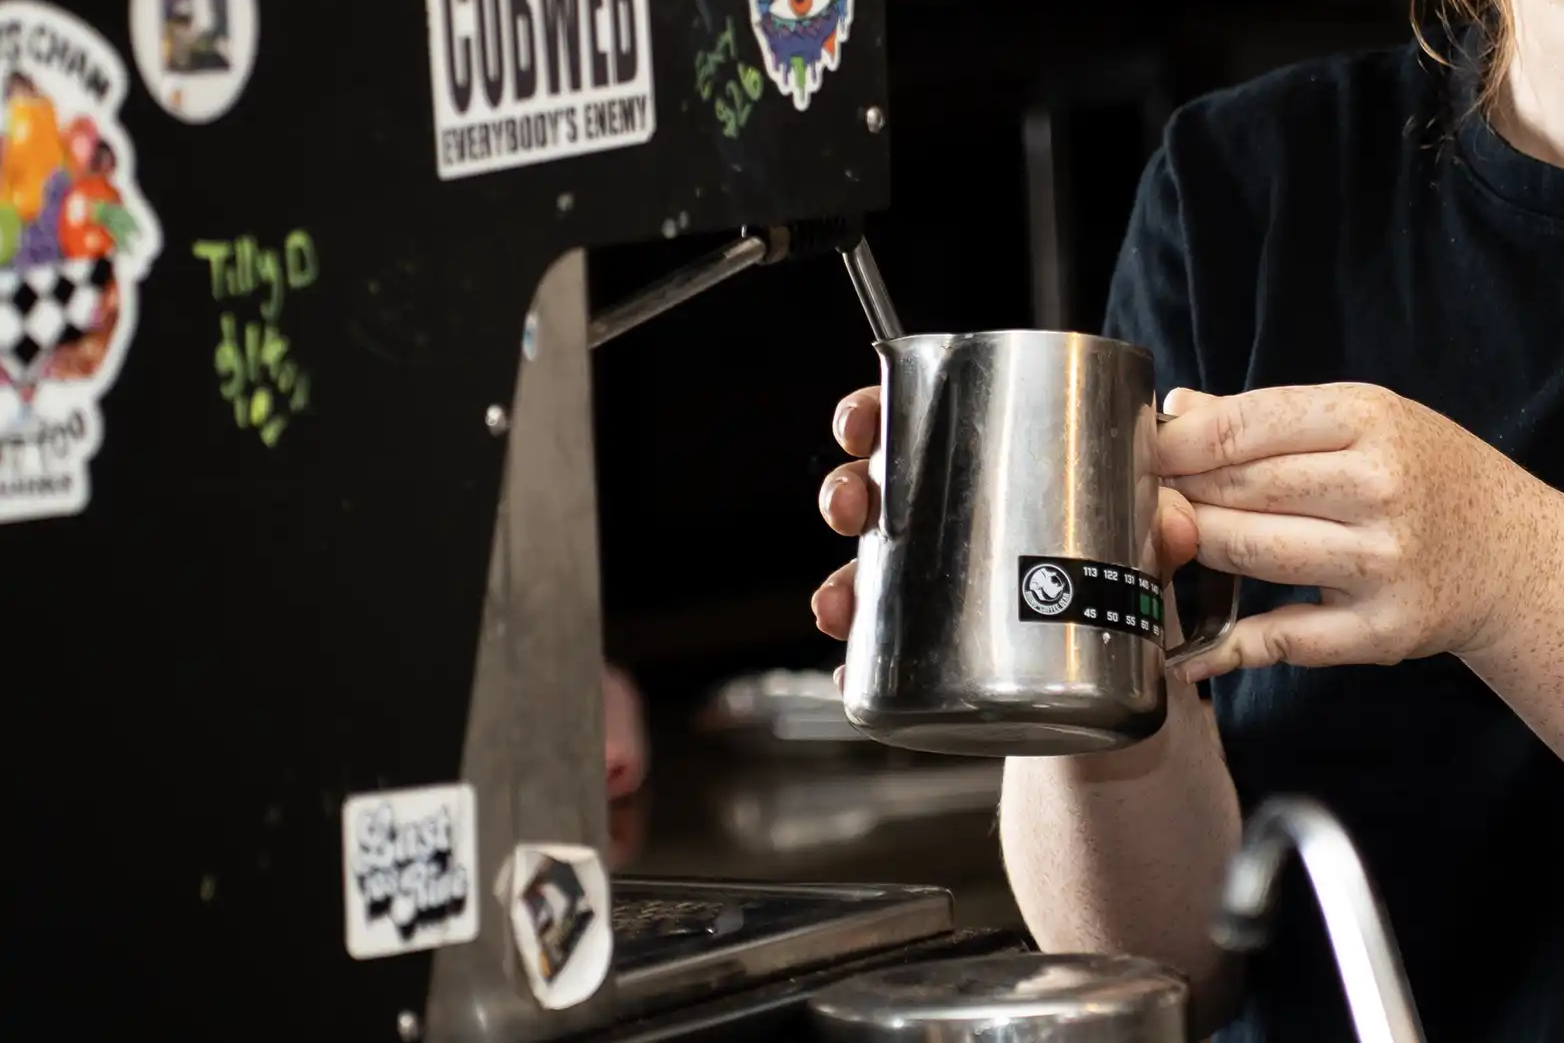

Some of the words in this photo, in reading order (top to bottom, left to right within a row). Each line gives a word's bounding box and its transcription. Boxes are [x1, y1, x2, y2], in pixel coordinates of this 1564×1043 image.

[442, 108, 577, 166] EVERYBODY'S
[584, 96, 647, 140] ENEMY
[1083, 566, 1098, 577] 113
[1103, 569, 1119, 581] 122
[1124, 573, 1135, 585] 131
[1083, 608, 1097, 618] 45
[1106, 611, 1118, 622] 50
[1125, 615, 1136, 626] 55
